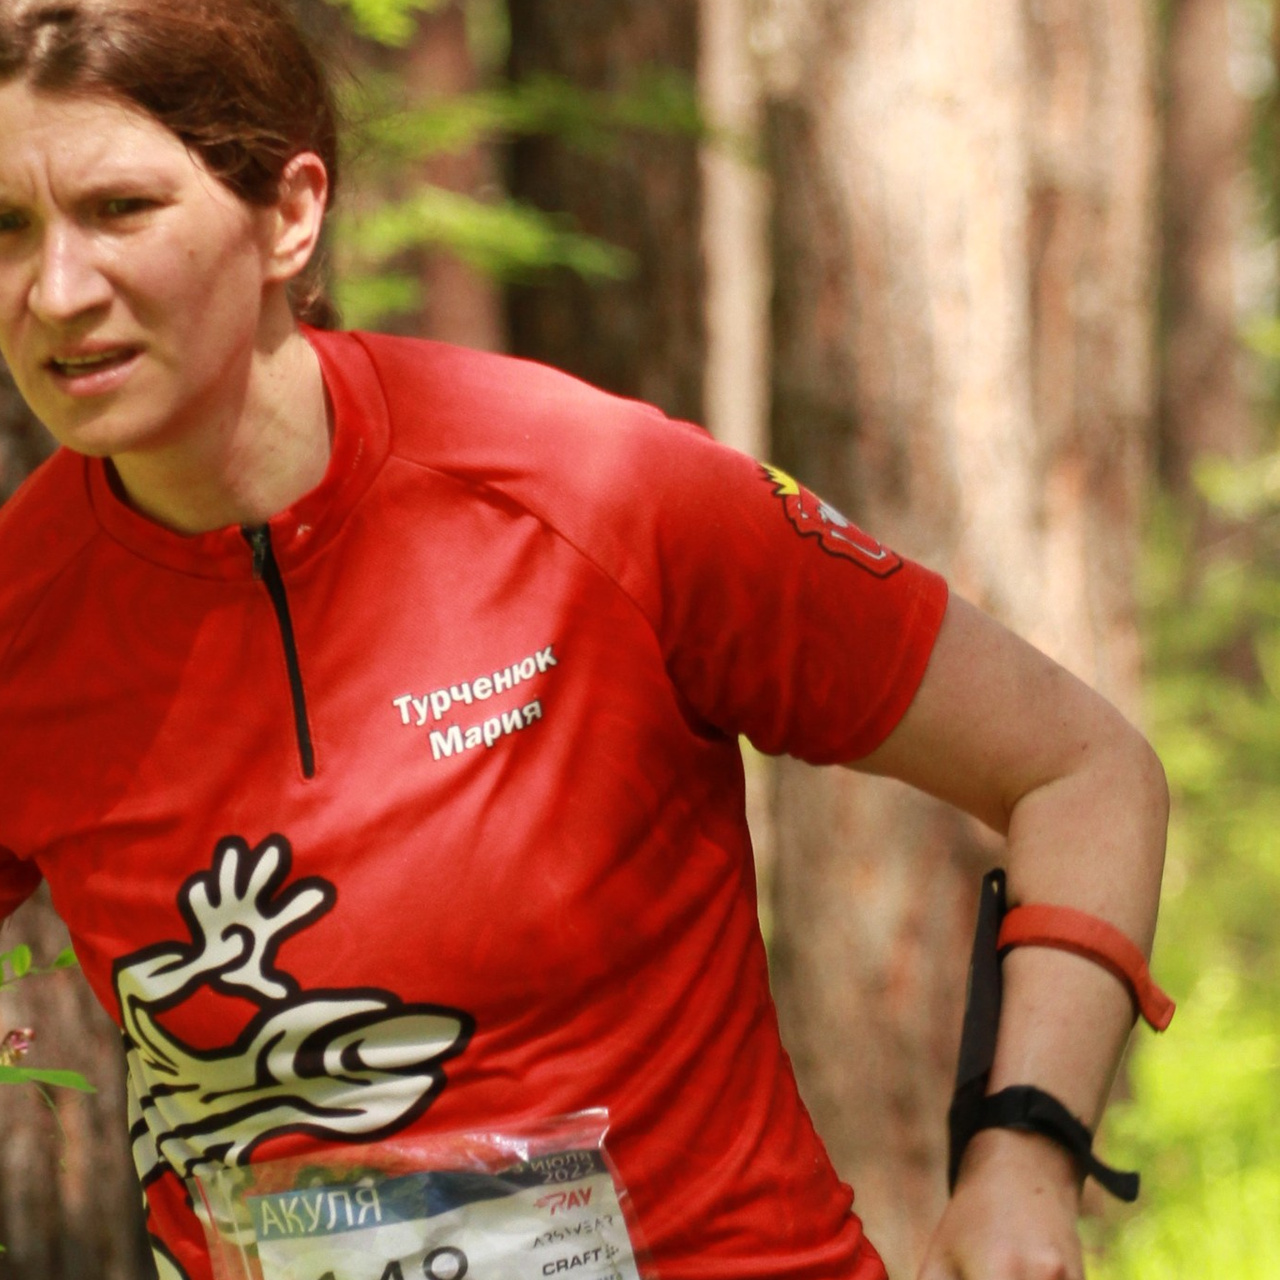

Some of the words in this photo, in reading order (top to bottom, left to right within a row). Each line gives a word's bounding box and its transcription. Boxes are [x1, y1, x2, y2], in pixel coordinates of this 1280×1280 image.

[392, 645, 557, 726] Турченюк
[428, 698, 543, 761] Мария
[260, 1188, 382, 1236] АКУЛЯ
[542, 1248, 602, 1277] CRAFT
